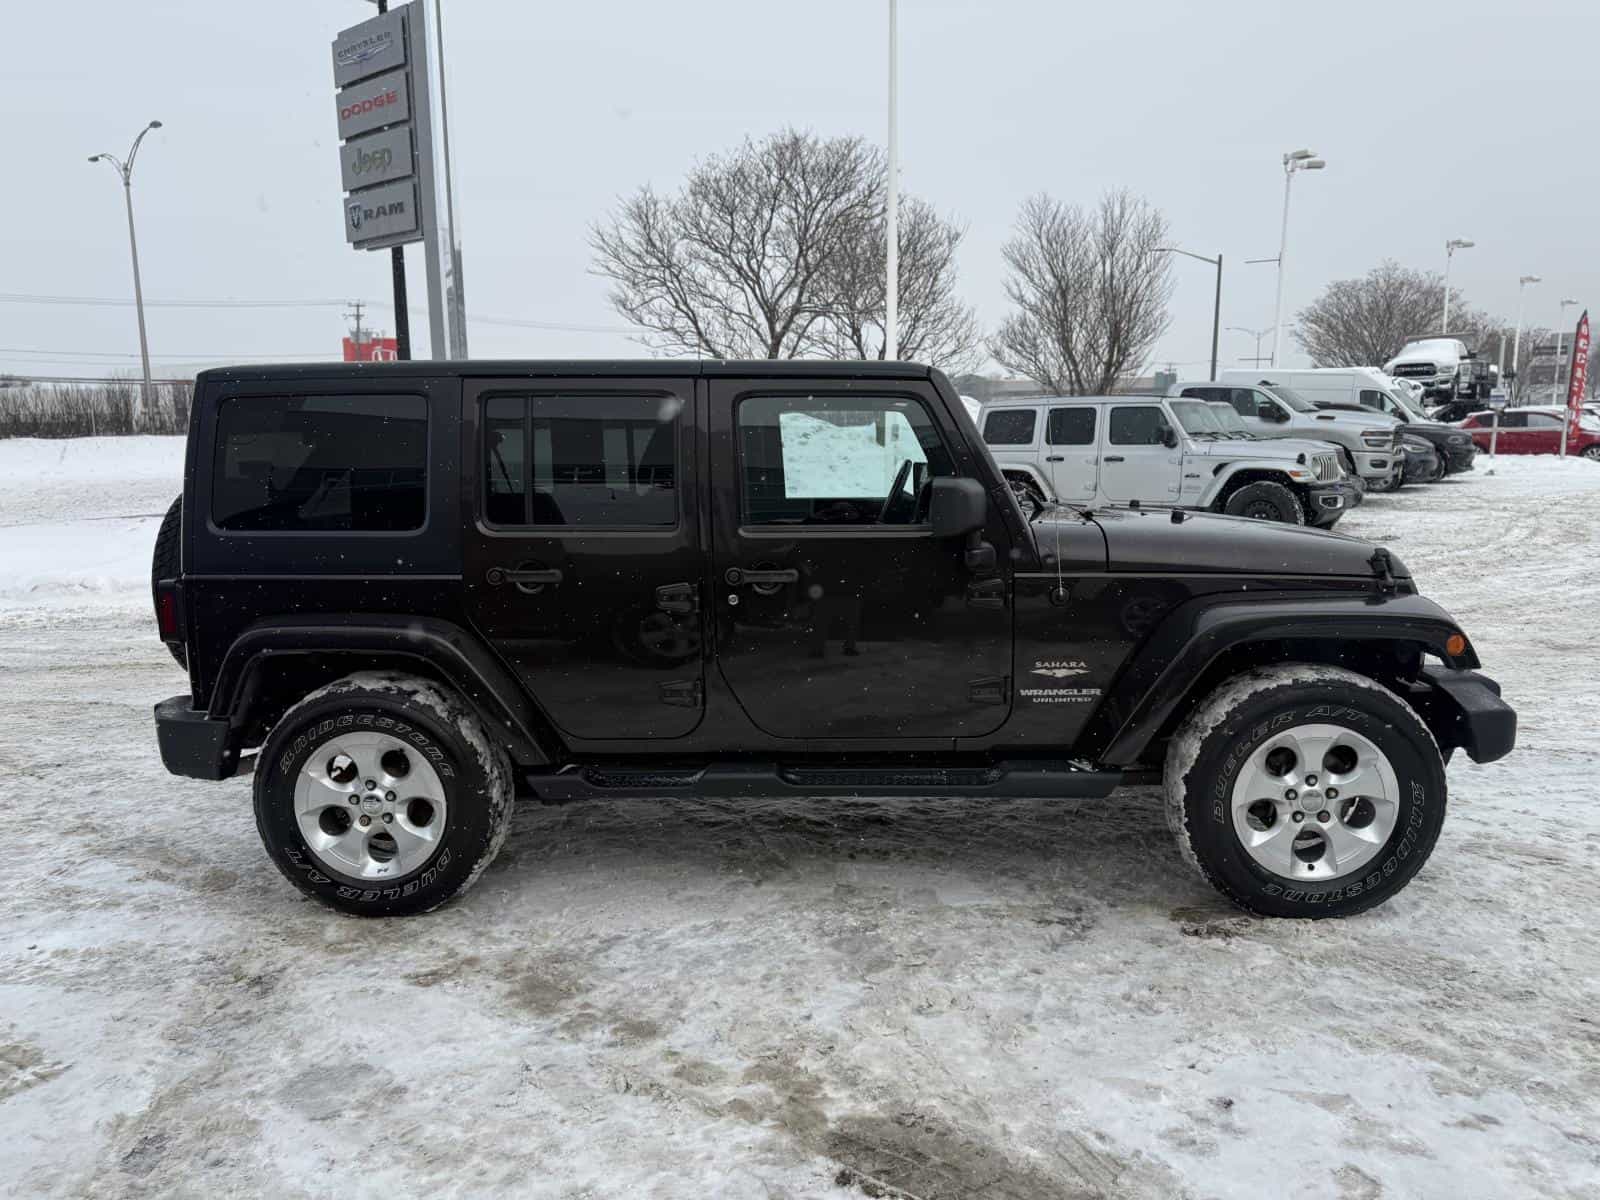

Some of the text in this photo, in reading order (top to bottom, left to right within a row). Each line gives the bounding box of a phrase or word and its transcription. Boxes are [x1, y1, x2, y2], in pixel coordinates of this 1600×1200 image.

[337, 31, 392, 58] CHRYSLER
[341, 91, 398, 120] DODGE
[352, 147, 393, 177] Jeep
[363, 201, 405, 222] RAM
[1020, 688, 1103, 697] WRANGLER
[280, 714, 455, 777] BRIDGESTONE
[1214, 704, 1369, 824] DUELER A/T
[1262, 780, 1426, 904] BRIDGESTONE
[336, 848, 452, 902] DUELER
